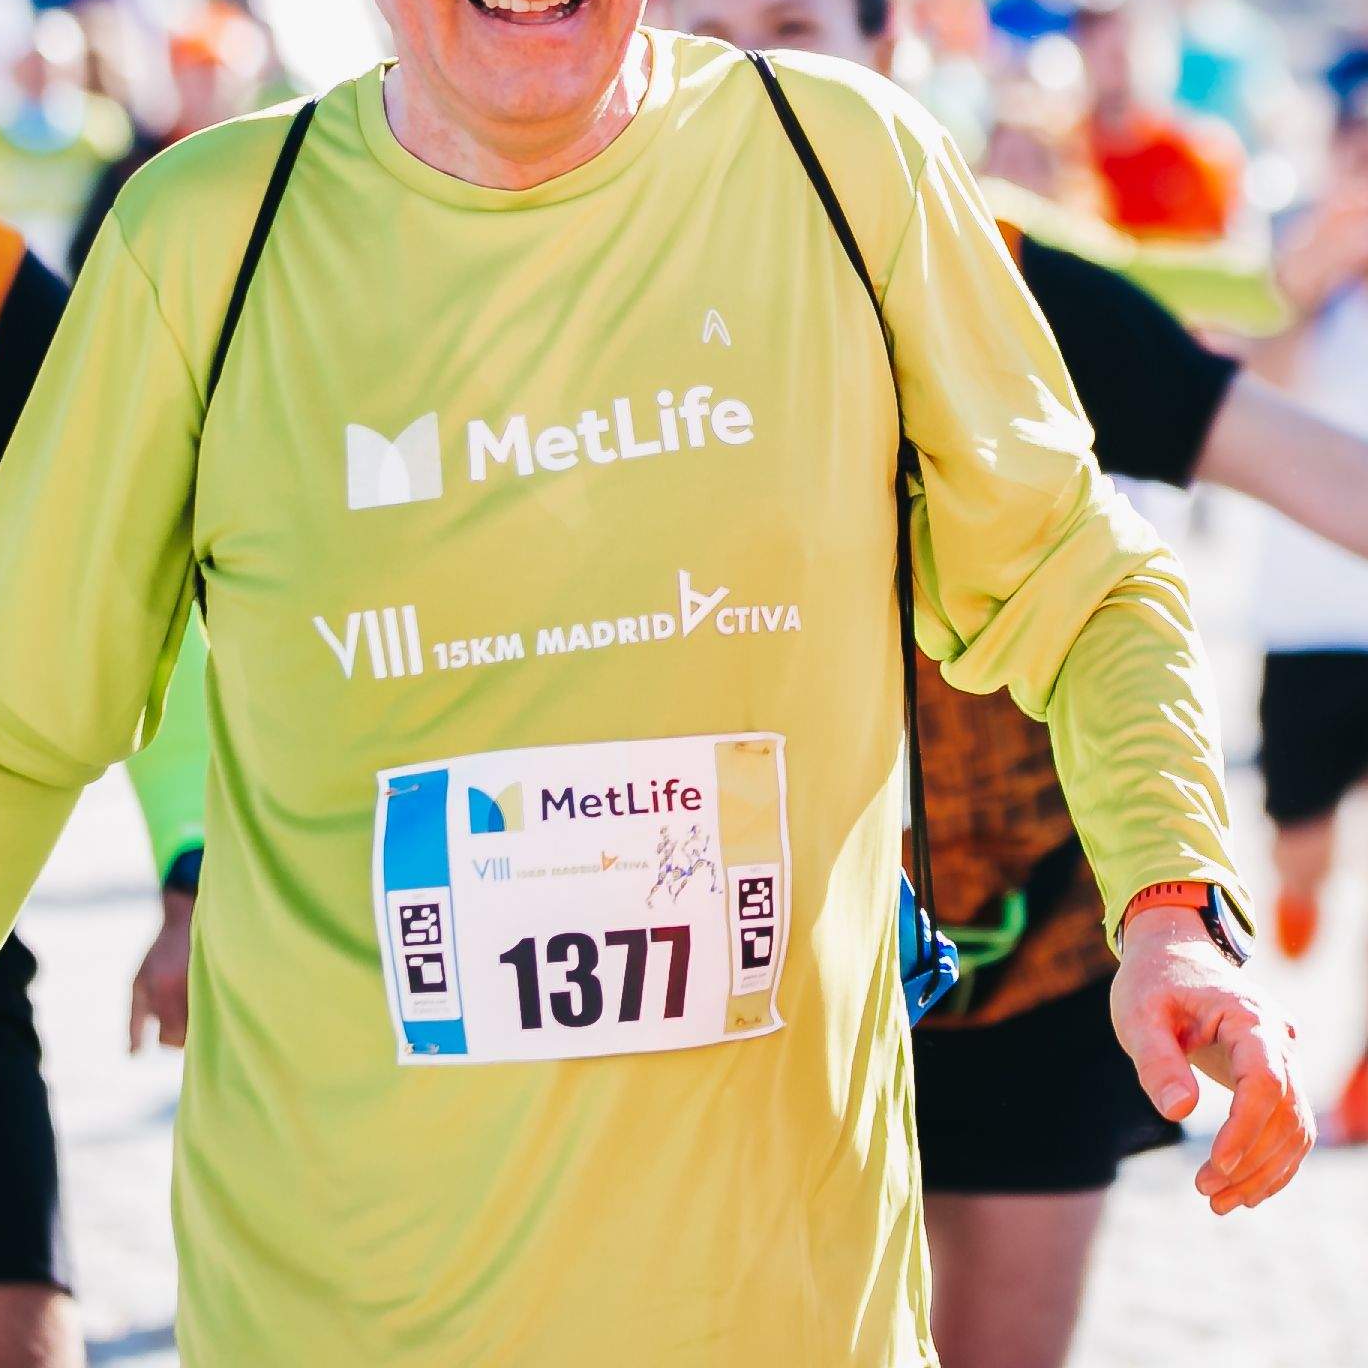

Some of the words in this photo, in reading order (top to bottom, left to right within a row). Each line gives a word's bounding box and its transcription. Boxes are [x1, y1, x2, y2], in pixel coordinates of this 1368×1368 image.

[467, 385, 754, 481] MetLife
[312, 604, 423, 679] VIII
[433, 633, 525, 670] 15KM
[541, 779, 702, 821] MetLife
[472, 856, 511, 881] VIII
[499, 925, 690, 1029] 1377
